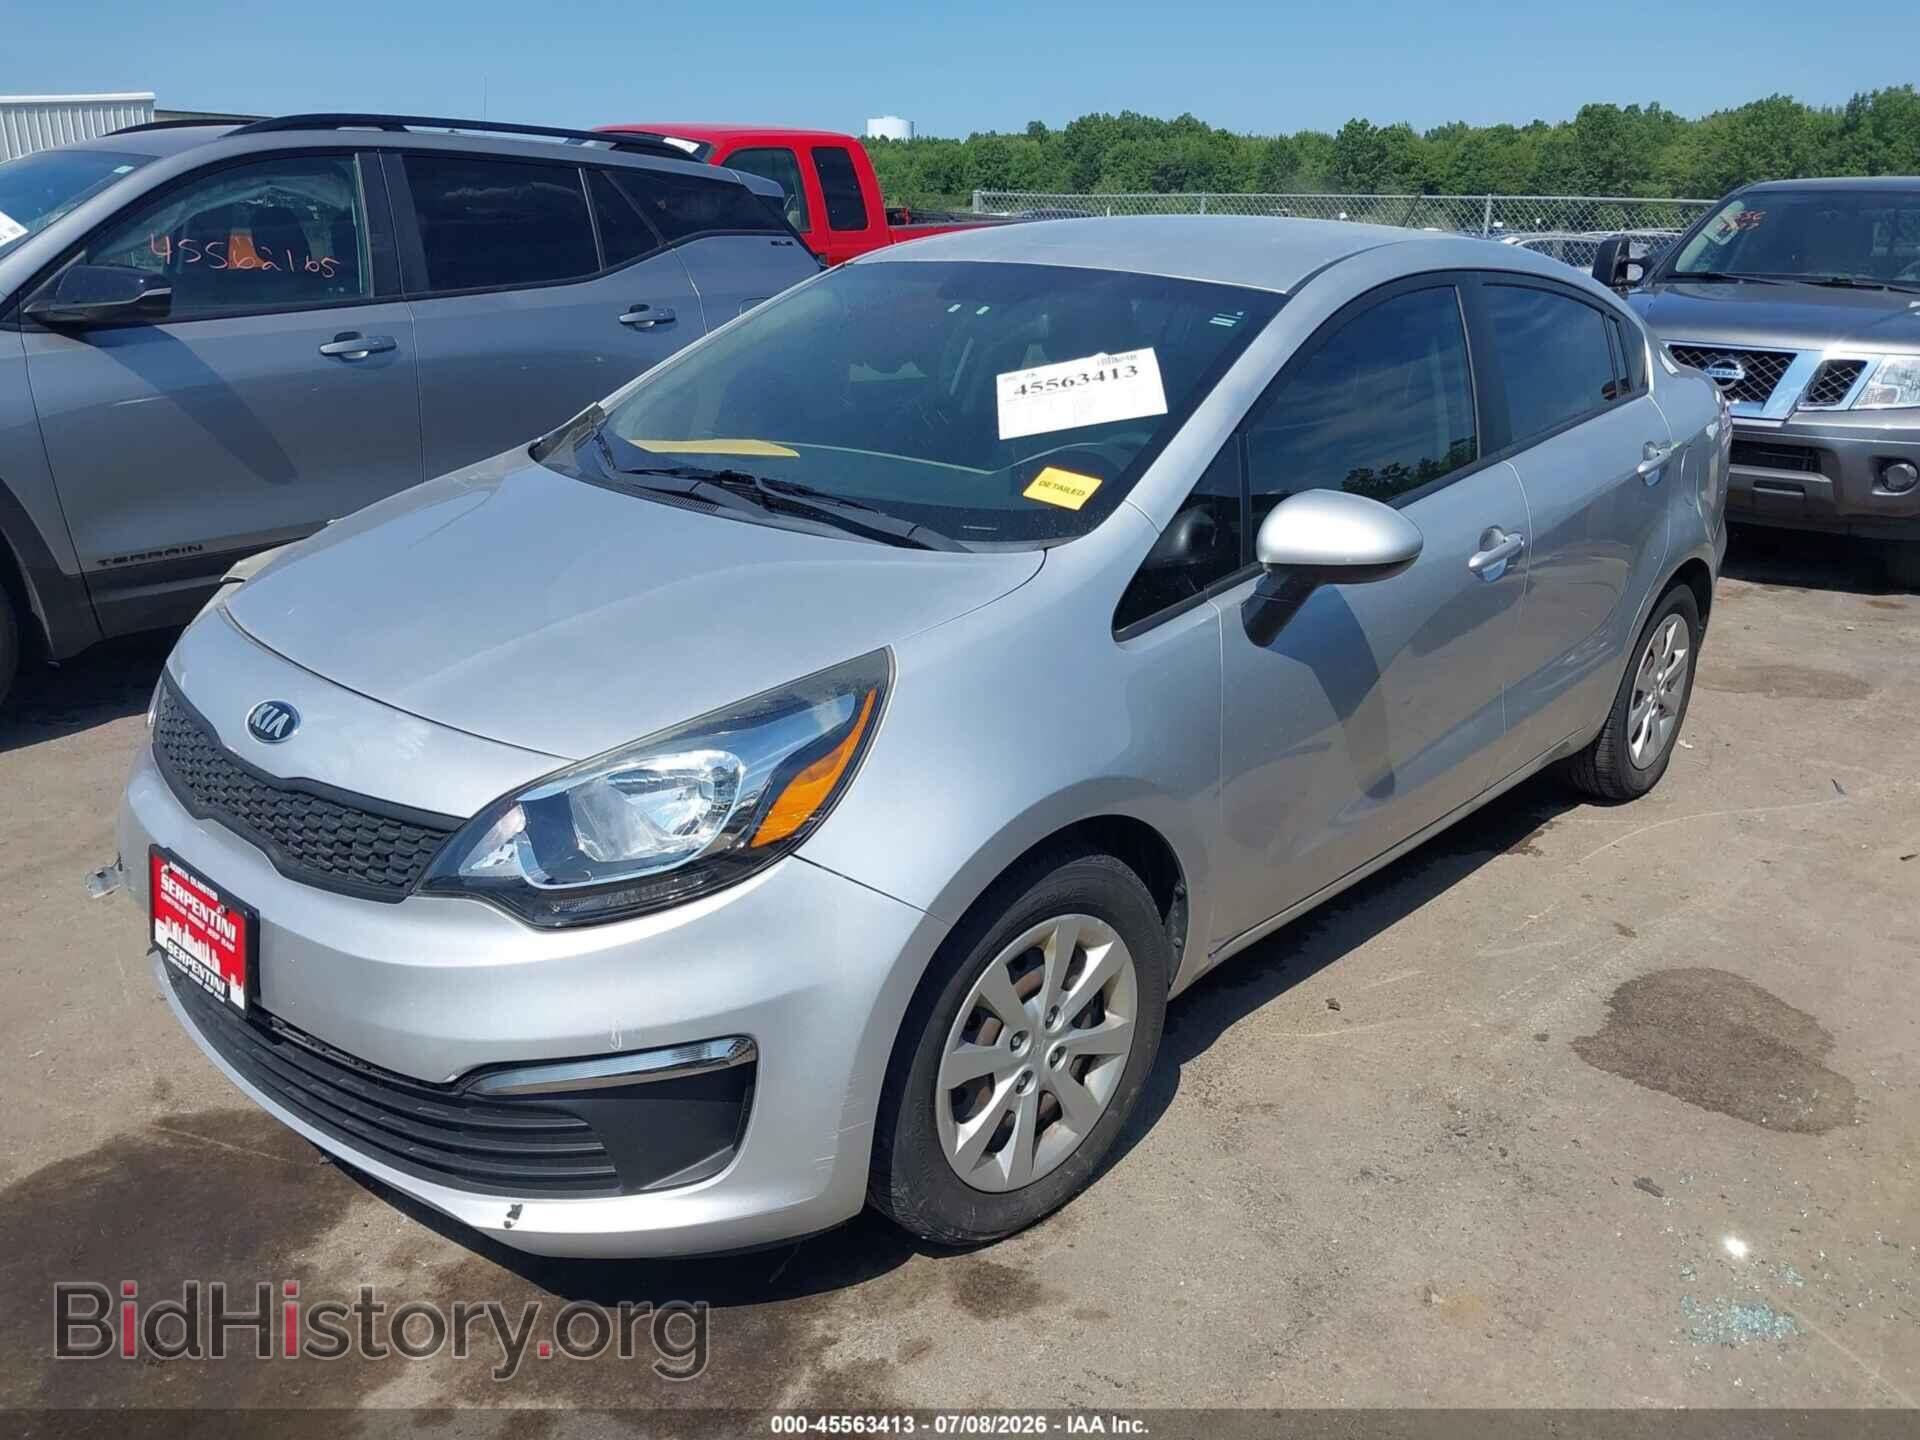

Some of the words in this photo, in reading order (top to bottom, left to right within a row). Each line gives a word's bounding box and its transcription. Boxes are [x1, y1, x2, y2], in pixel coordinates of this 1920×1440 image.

[1013, 365, 1139, 396] 45563413
[1038, 480, 1086, 497] DETAILED
[96, 544, 203, 566] TERRAIN
[251, 703, 290, 738] KIA
[160, 873, 237, 942] SERPENTINI
[167, 940, 226, 995] SERPENTINI
